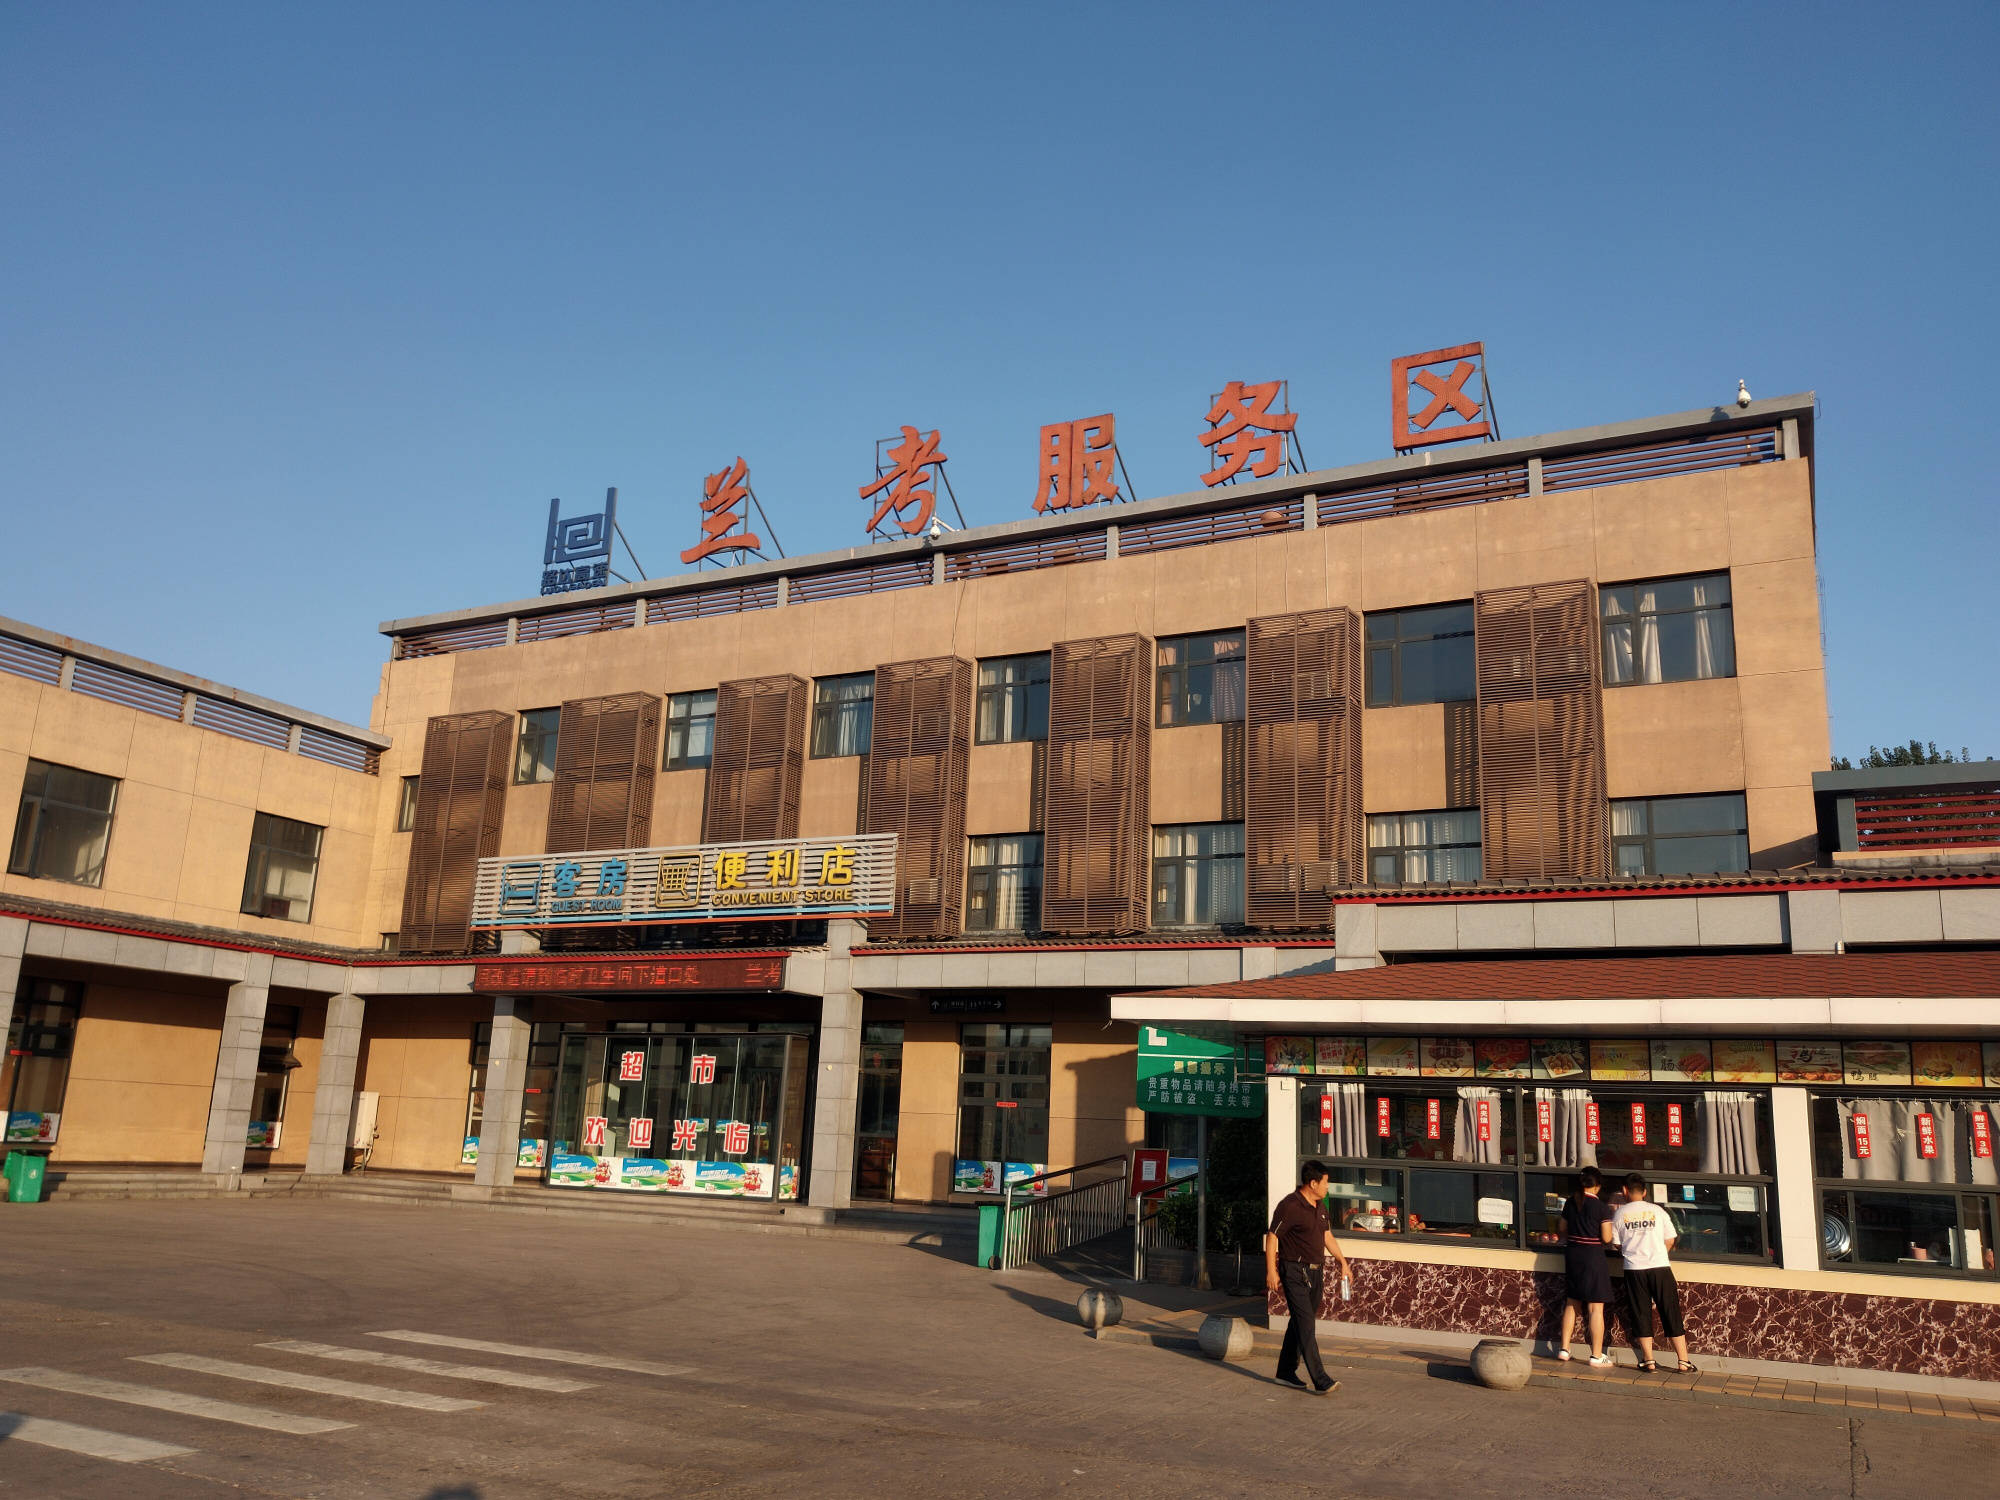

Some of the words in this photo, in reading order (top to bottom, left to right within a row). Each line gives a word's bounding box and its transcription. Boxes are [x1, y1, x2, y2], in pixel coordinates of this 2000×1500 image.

[680, 341, 1490, 564] 兰考服务区
[713, 844, 856, 890] 便利店
[551, 858, 628, 897] 客房
[712, 890, 800, 905] CONVENIENT
[804, 888, 854, 902] STORE
[552, 899, 586, 912] GUEST
[590, 898, 622, 911] ROOM
[619, 1051, 717, 1084] 超市
[1380, 1101, 1388, 1116] 玉米
[1429, 1102, 1438, 1122] 茶鸡蛋
[1480, 1104, 1488, 1124] 肉夹馍
[1540, 1104, 1549, 1125] 手抓饼
[1634, 1106, 1643, 1123] 凉皮
[1380, 1119, 1389, 1134] 5元
[1430, 1125, 1438, 1136] 2元
[1481, 1126, 1489, 1138] 5元
[1541, 1127, 1550, 1140] 6元
[1634, 1126, 1645, 1142] 10元
[1974, 1114, 1987, 1138] 鲜豆浆
[584, 1116, 751, 1155] 欢迎光临
[1589, 1129, 1598, 1141] 6元
[1670, 1127, 1680, 1143] 10元
[1920, 1117, 1935, 1154] 新鲜水果
[1857, 1138, 1869, 1154] 15元
[1979, 1140, 1989, 1155] 3元
[1624, 1220, 1656, 1230] VISION
